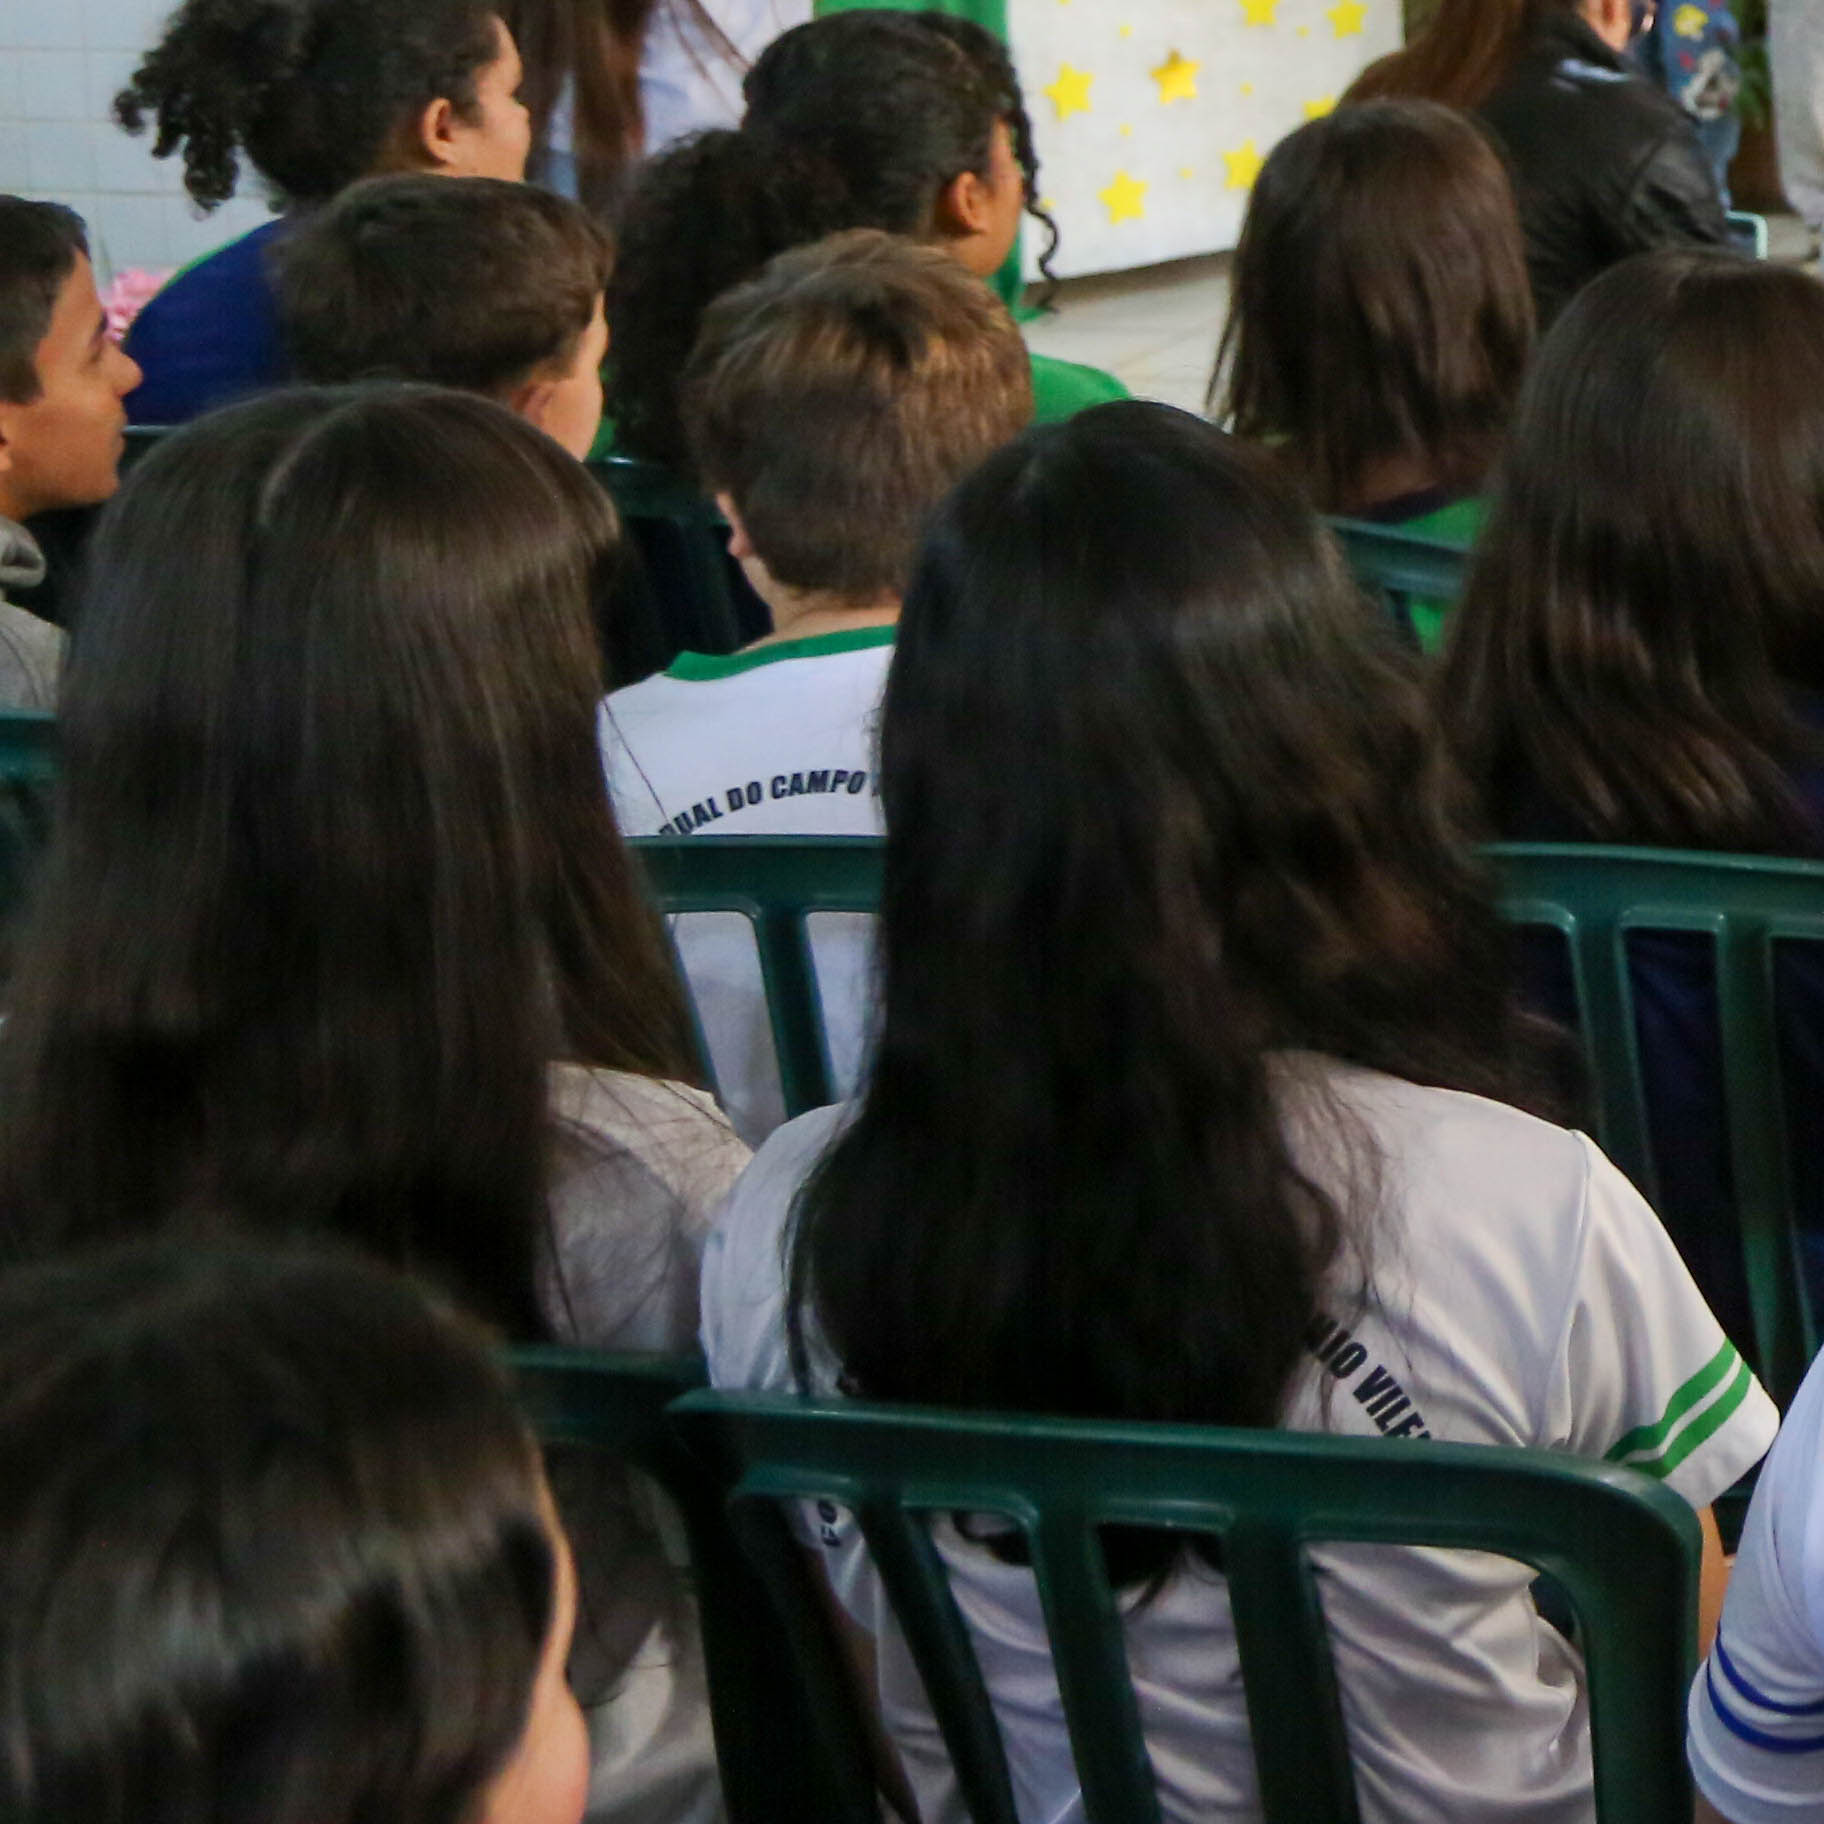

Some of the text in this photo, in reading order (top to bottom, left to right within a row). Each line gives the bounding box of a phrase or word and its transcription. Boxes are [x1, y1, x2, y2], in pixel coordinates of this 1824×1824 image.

[726, 780, 763, 812] DO
[770, 769, 867, 800] CAMPO
[1352, 1363, 1431, 1440] VILE
